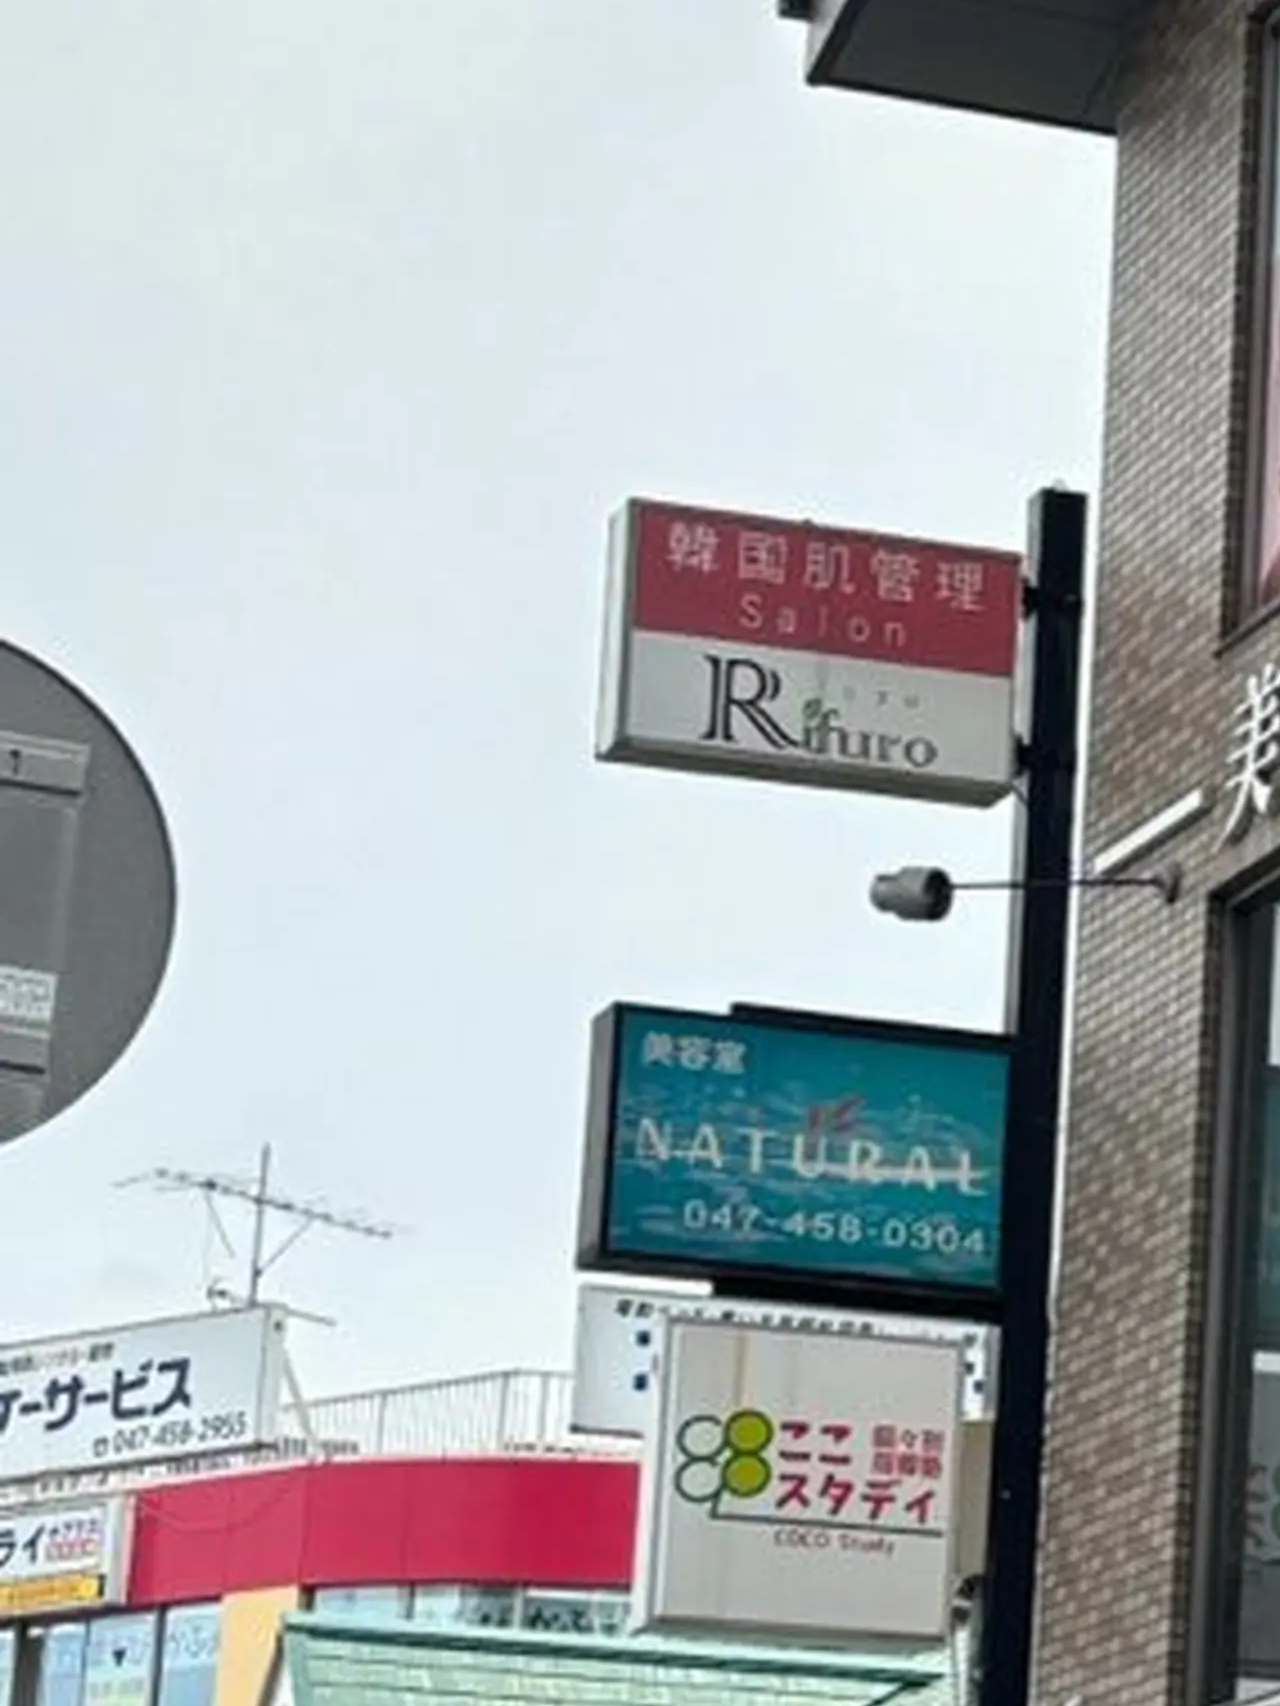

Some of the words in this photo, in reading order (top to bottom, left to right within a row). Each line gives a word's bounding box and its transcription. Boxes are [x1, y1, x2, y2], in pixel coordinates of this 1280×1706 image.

[738, 593, 908, 648] Salon
[701, 652, 940, 769] Rifuro
[642, 1030, 747, 1076] 美容室
[634, 1116, 992, 1197] NATURAL
[682, 1198, 987, 1254] 047-458-0304
[778, 1421, 853, 1467] ここ
[775, 1472, 937, 1525] スタディ
